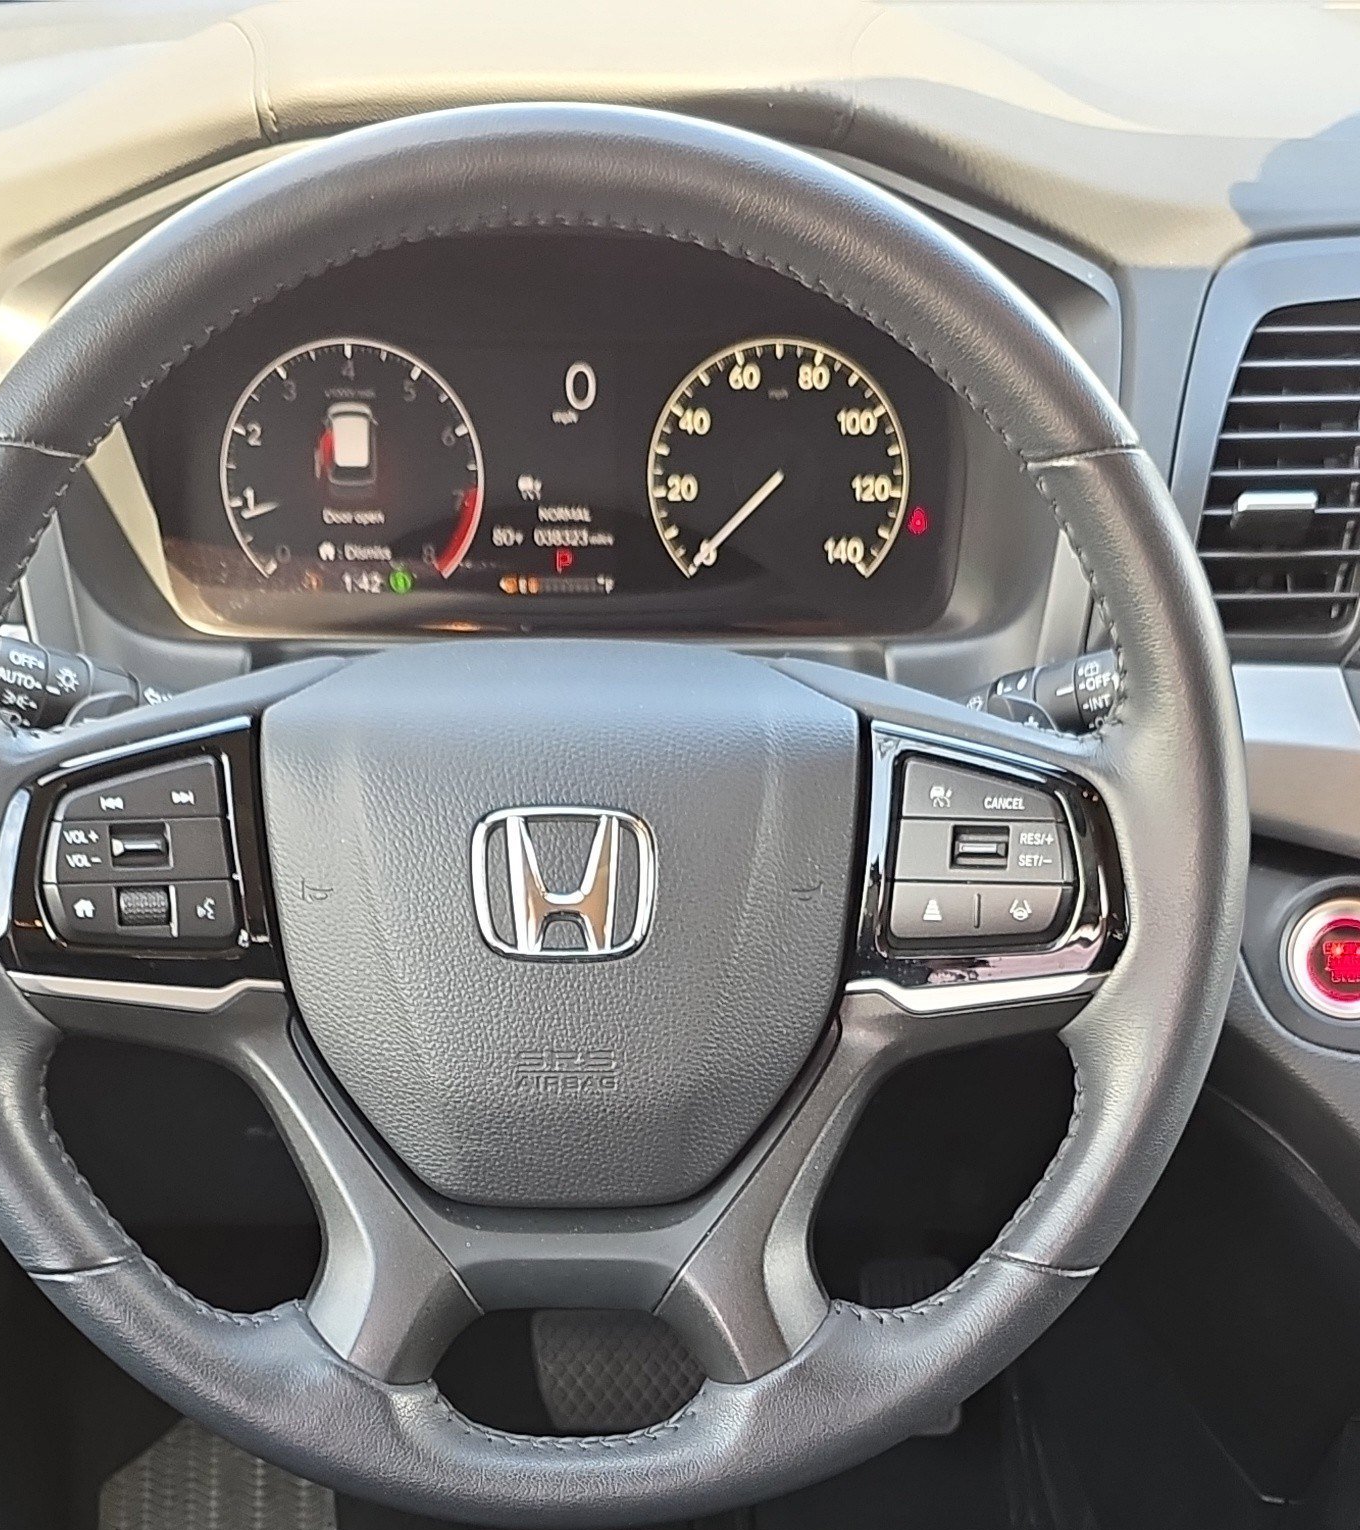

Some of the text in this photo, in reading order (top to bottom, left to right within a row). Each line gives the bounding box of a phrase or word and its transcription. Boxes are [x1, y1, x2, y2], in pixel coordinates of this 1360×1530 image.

[565, 361, 597, 411] 0
[728, 362, 761, 391] 60
[798, 362, 831, 391] 80
[246, 422, 262, 446] 2
[679, 407, 711, 436] 40
[837, 407, 878, 436] 100
[667, 474, 698, 502] 20
[851, 475, 891, 503] 120
[538, 505, 591, 522] NORMAL
[556, 548, 573, 574] P
[824, 537, 865, 564] 140
[9, 650, 38, 668] OFF
[1085, 674, 1111, 692] OFF
[1089, 694, 1111, 711] INT
[984, 796, 1026, 811] CANCEL
[1019, 832, 1055, 846] RES/+
